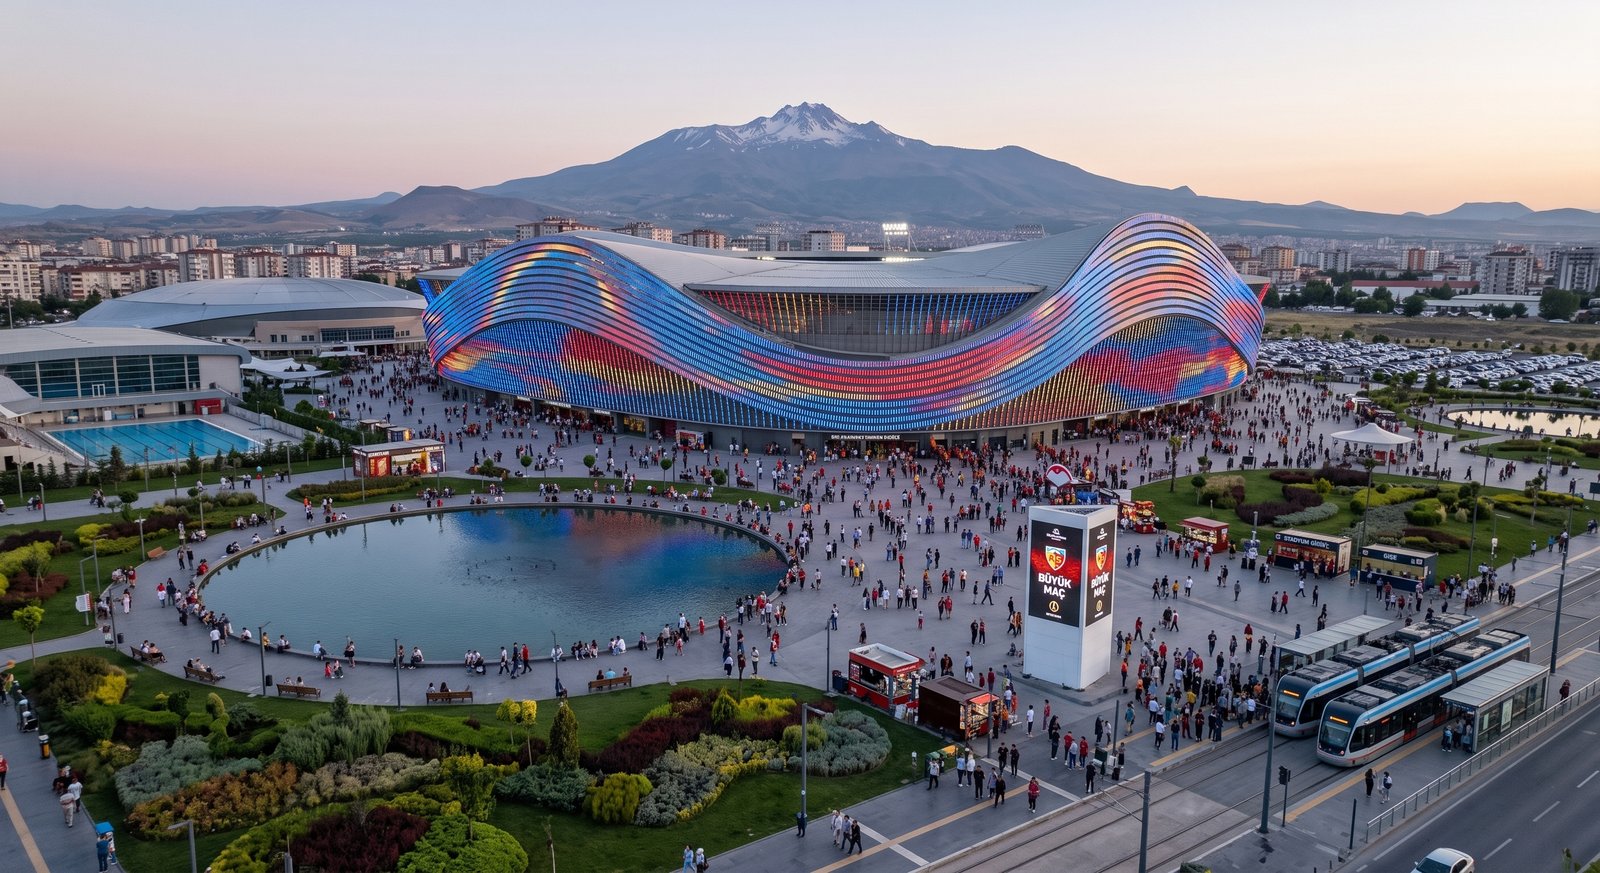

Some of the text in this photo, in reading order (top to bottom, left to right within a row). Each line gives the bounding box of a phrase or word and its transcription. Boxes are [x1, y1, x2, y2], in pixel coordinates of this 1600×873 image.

[1038, 573, 1072, 589] BÜYÜK
[1091, 572, 1110, 589] BÜYÜK
[1043, 584, 1066, 600] MAÇ
[1093, 584, 1106, 598] MAÇ
